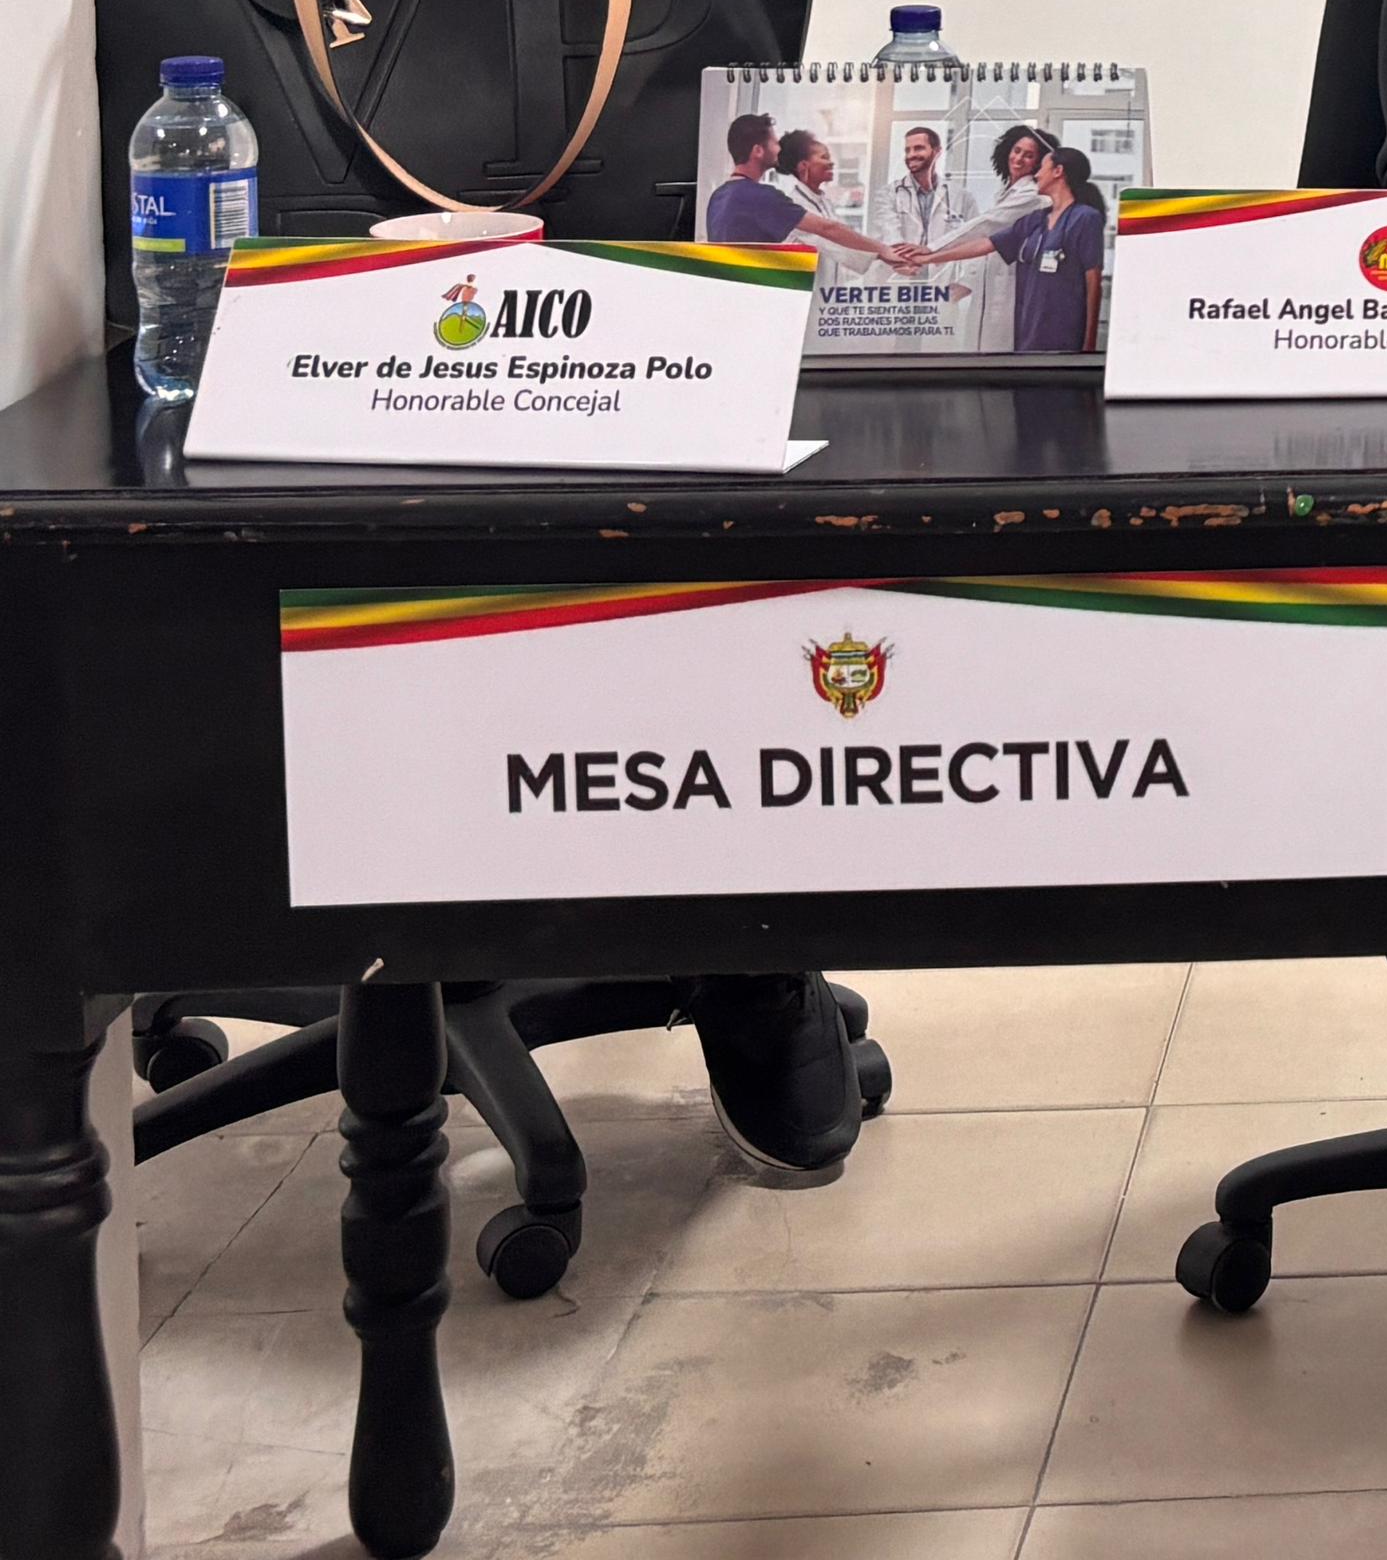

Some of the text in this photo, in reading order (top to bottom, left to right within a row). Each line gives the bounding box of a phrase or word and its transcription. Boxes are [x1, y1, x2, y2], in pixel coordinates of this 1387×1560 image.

[819, 285, 950, 304] VERTE BIEN
[490, 289, 593, 339] AICO
[818, 316, 938, 327] DOS RAZONES POR LAS
[819, 306, 826, 316] Y
[853, 306, 865, 316] TE
[867, 305, 911, 315] SIENTAS
[1188, 297, 1271, 320] Rafael
[1277, 298, 1354, 325] Angel
[818, 327, 840, 337] QUE
[842, 326, 912, 337] TRABAJAMOS
[914, 326, 942, 336] PARA
[291, 354, 713, 385] Elver de Jesus Espinoza Polo
[371, 388, 621, 417] Honorable Concejal
[506, 738, 1190, 814] MESA DIRECTIVA
